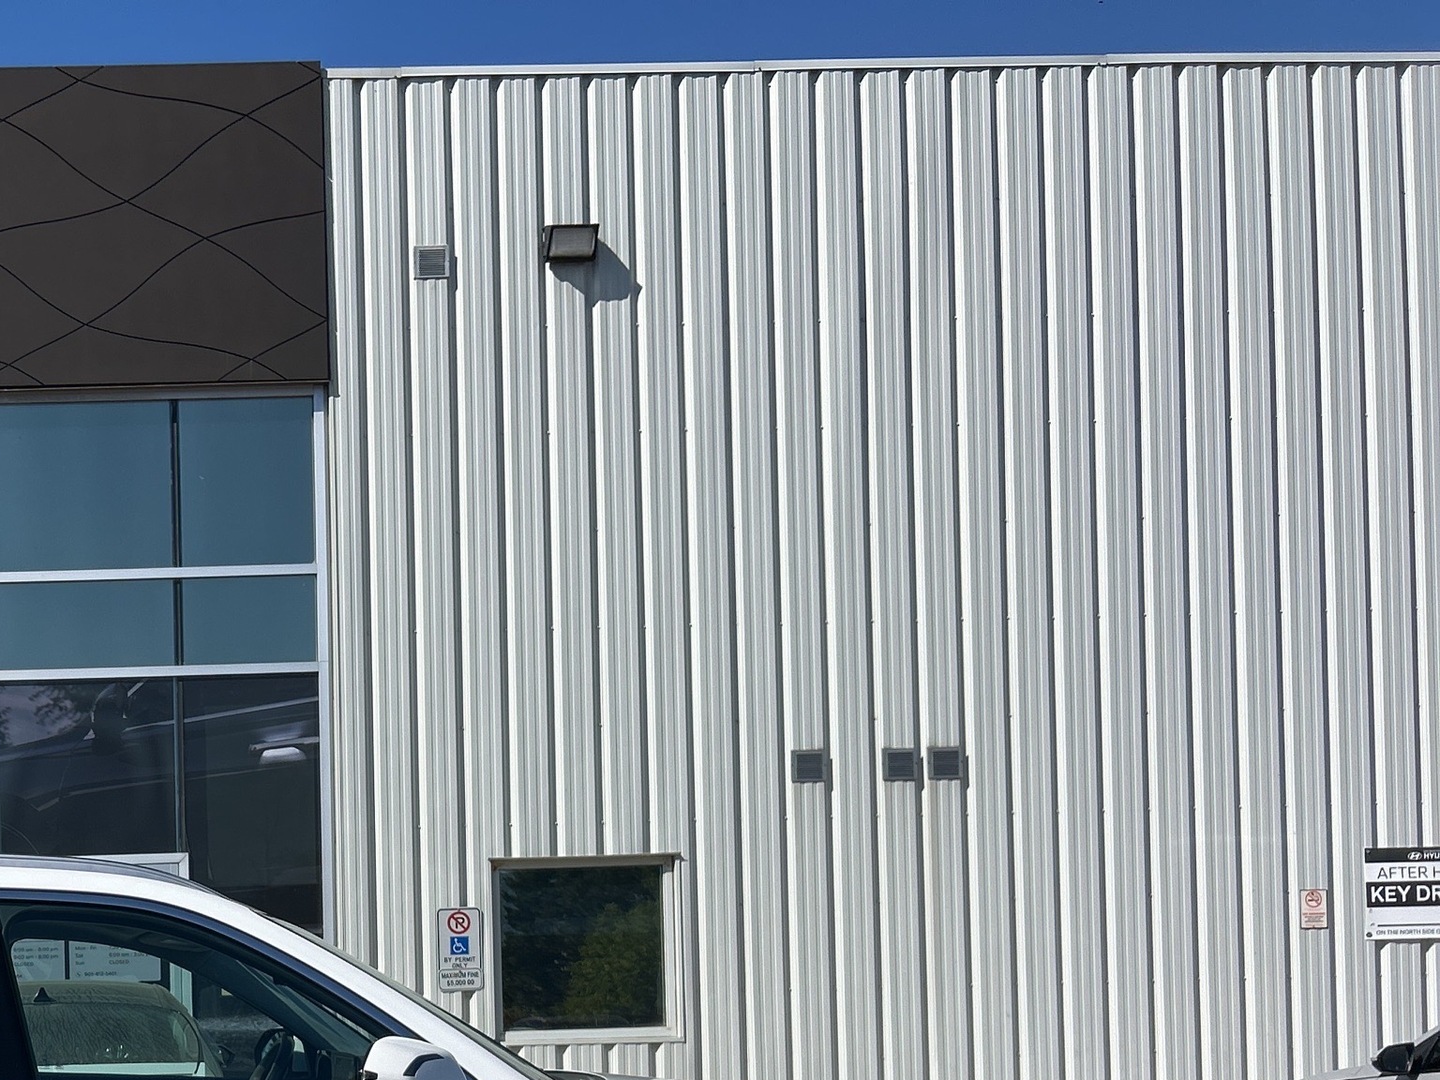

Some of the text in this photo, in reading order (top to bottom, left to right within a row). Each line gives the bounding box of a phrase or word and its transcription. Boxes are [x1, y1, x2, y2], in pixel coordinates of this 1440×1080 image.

[1377, 866, 1428, 879] AFTER
[1370, 884, 1440, 903] KEY DR
